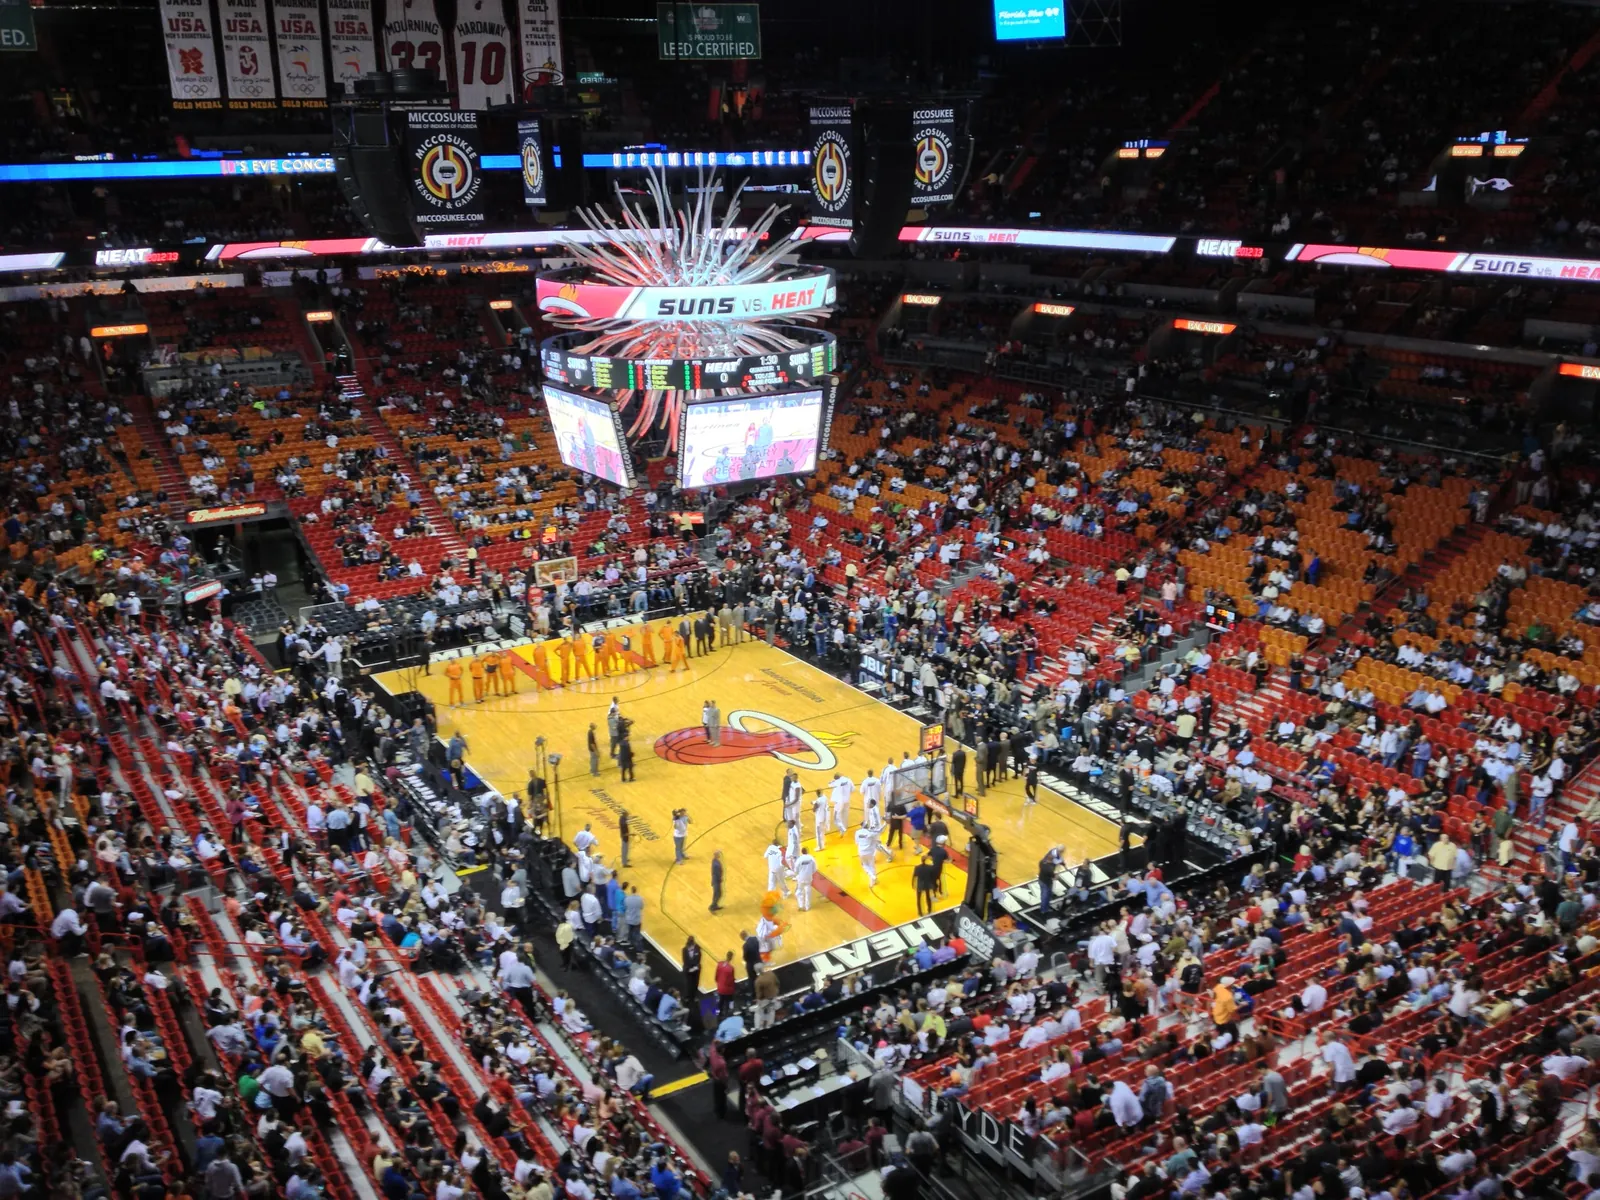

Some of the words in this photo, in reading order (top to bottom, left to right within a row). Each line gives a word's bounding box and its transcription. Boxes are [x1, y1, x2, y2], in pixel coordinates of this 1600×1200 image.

[168, 18, 206, 32] USA
[226, 19, 262, 33] USA
[280, 20, 316, 34] USA
[334, 21, 368, 35] USA
[384, 19, 439, 36] MOURNING
[456, 21, 506, 38] HARDAWAY
[663, 42, 693, 55] LEED
[696, 42, 757, 55] CERTIFIED.
[461, 41, 506, 85] 10
[195, 101, 222, 109] MEDAL
[229, 101, 249, 109] GOLD
[251, 100, 277, 109] MEDAL
[408, 112, 477, 122] MICCOSUKEE
[810, 107, 851, 117] MICCOSUKEE
[912, 109, 954, 119] ICCOSUKEE
[812, 130, 850, 157] MICCOSUKEE
[913, 128, 953, 149] ICCOSUKEE
[415, 134, 477, 159] MICCOSUKEE
[252, 159, 277, 171] EVE
[612, 152, 717, 168] UPCOMING
[933, 163, 954, 190] GAMING
[414, 178, 444, 208] RESORT
[446, 201, 453, 209] &
[454, 177, 481, 208] GAMING
[834, 178, 852, 211] GAMING
[911, 194, 953, 204] ICCOSUKEE.COM
[416, 213, 485, 223] MICCOSUKEE.COM
[447, 234, 487, 246] HEAT
[934, 231, 971, 241] SUNS
[988, 231, 1020, 243] HEAT
[1197, 239, 1242, 258] HEAT
[96, 247, 152, 266] HEAT
[1472, 259, 1533, 274] SUNS
[658, 297, 737, 315] SUNS
[742, 299, 767, 312] VS.
[771, 282, 817, 310] HEAT
[1187, 320, 1224, 334] BACARDI
[704, 357, 742, 373] HEAT
[760, 355, 779, 366] 1:30
[789, 352, 810, 366] SUNS
[797, 365, 804, 375] 0
[720, 373, 729, 383] 0
[821, 386, 837, 451] MICCOSUKEE.COM
[612, 411, 635, 478] MICCOSUKEE.COM
[960, 916, 995, 949] Office
[811, 917, 946, 993] HEAT
